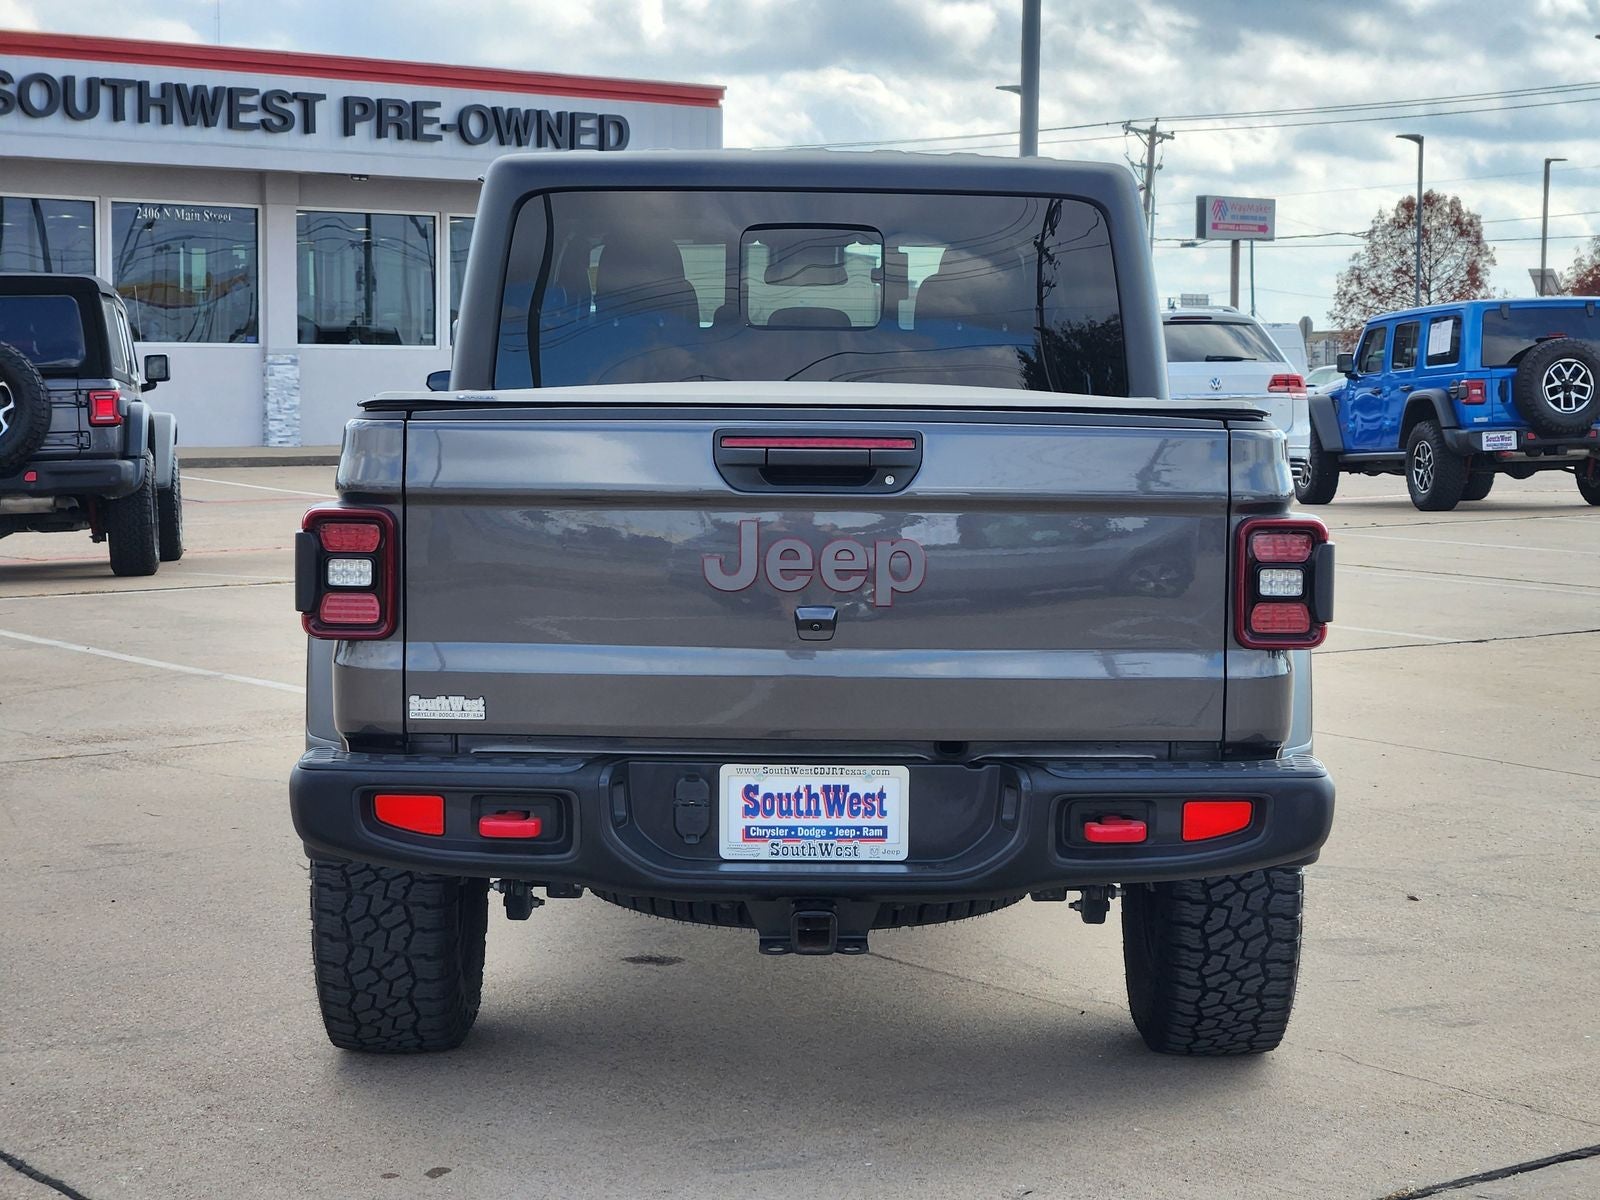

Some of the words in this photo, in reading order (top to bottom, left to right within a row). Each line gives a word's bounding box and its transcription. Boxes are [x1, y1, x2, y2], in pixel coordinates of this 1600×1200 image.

[343, 95, 630, 151] PRE-OWNED
[136, 206, 160, 219] 2406
[163, 207, 171, 217] N
[174, 208, 200, 221] Main
[203, 209, 231, 222] Street
[703, 519, 927, 608] Jeep
[409, 695, 485, 711] SouthWest
[742, 784, 888, 819] SouthWest
[750, 827, 789, 838] Chrysler
[797, 827, 827, 838] Dodge
[834, 827, 856, 838] Jeep
[862, 827, 883, 837] Ram
[770, 842, 859, 857] SouthWest
[881, 848, 901, 856] Jeep
